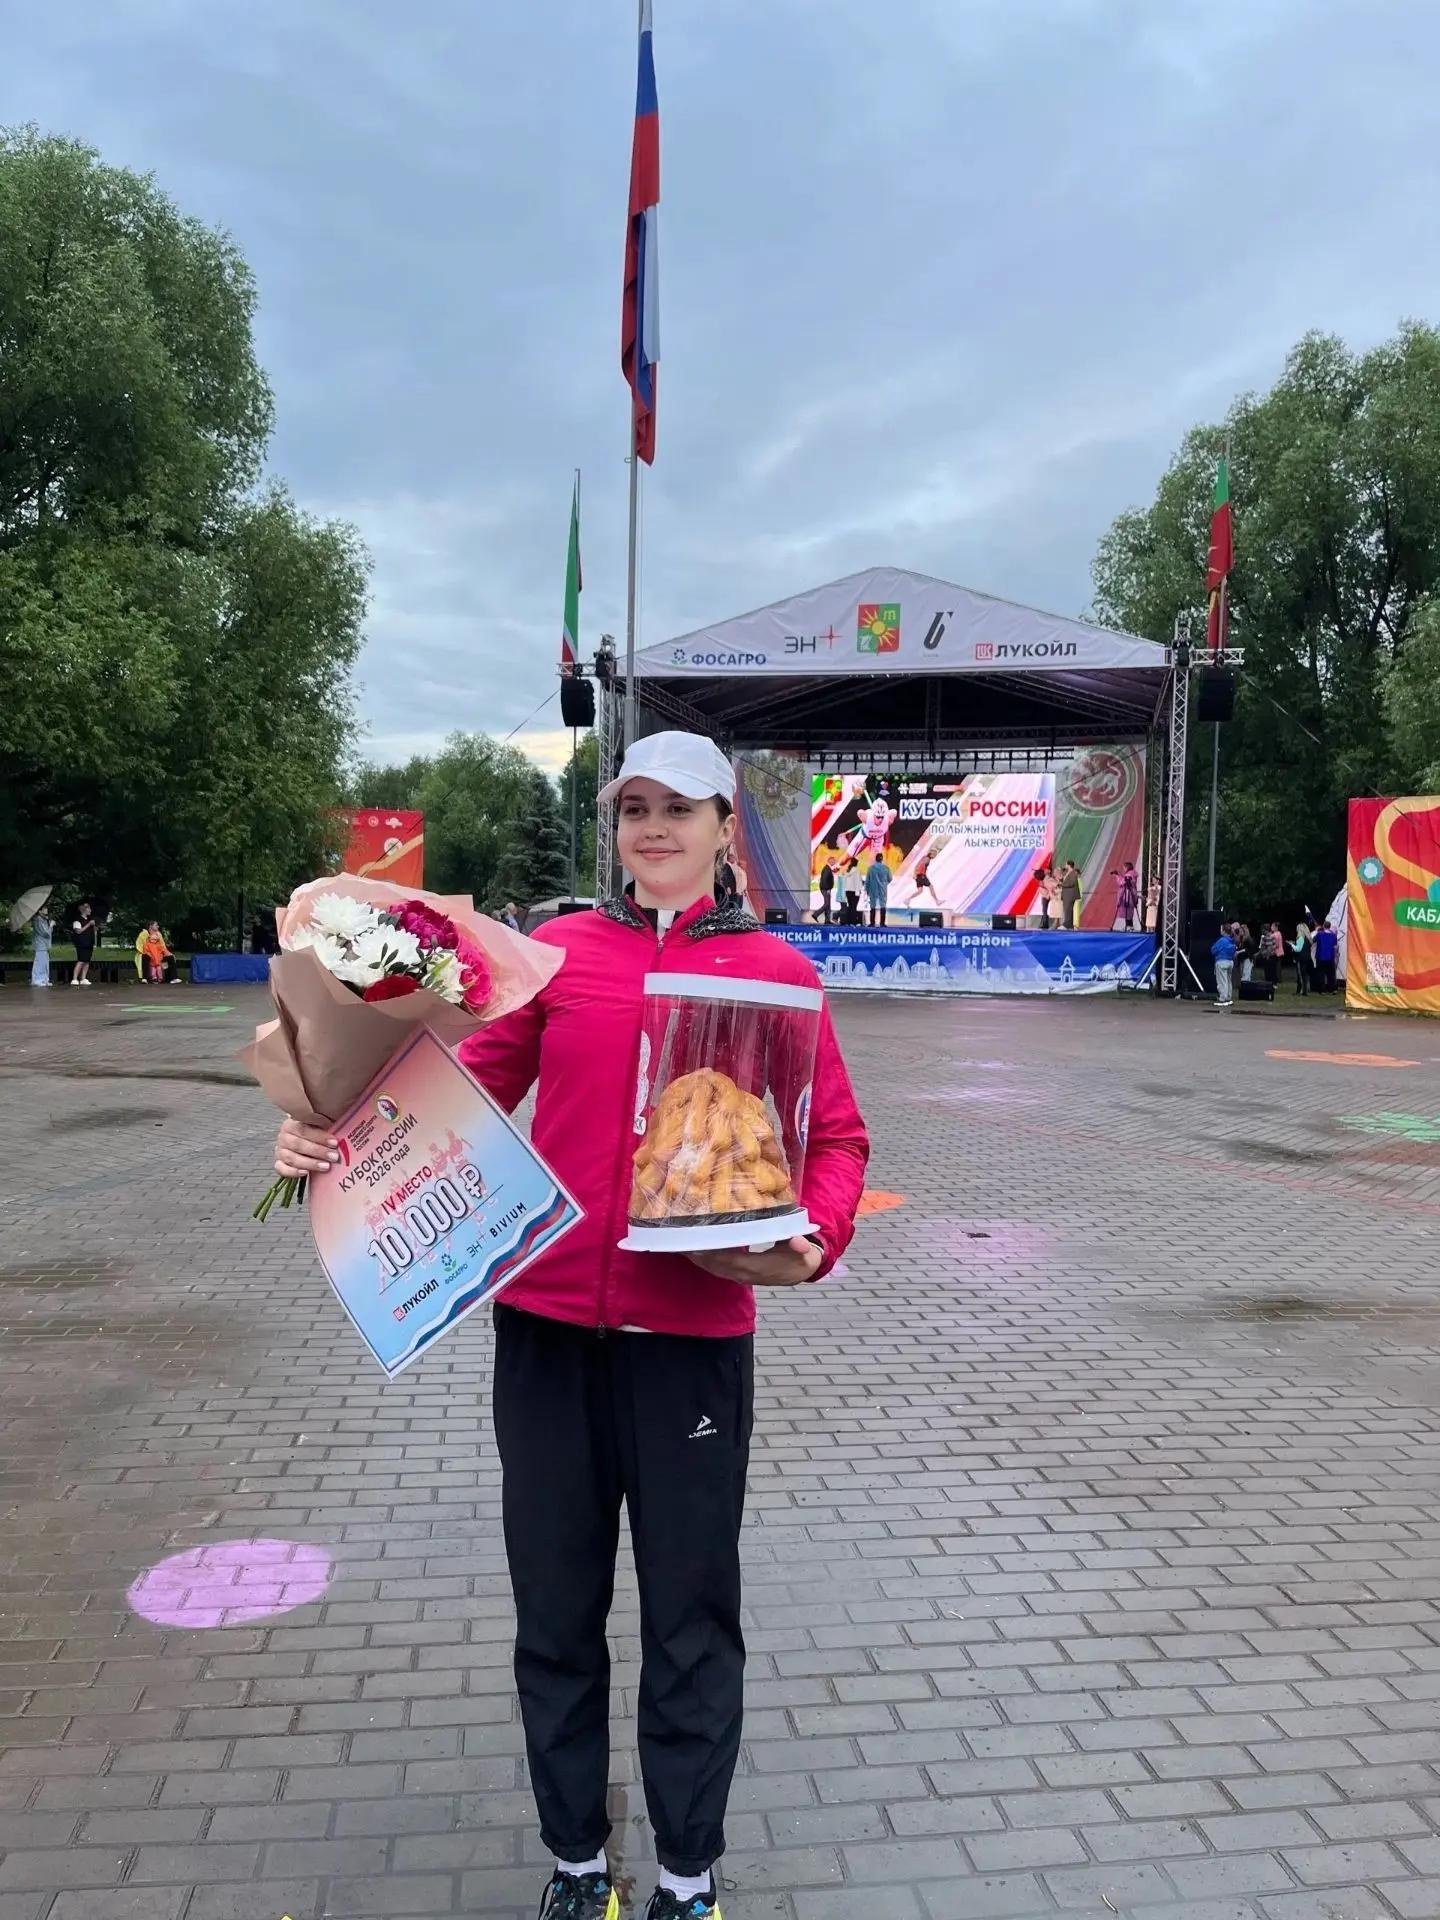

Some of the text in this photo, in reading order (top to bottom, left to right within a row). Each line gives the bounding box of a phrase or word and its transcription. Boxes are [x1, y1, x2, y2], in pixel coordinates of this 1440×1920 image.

[691, 653, 766, 666] ФОСАГРО
[994, 640, 1077, 658] ЛУКОЙЛ
[901, 800, 1047, 817] КУБОК РОССИИ
[931, 824, 1046, 834] ПО ЛЫЖНЫМ ГОНКАМ
[964, 837, 1046, 848] ЛЫЖЕРОЛЛЕРЫ
[828, 930, 957, 947] муниципальный
[961, 931, 1011, 947] район
[338, 1112, 418, 1193] КУБОК РОССИИ
[366, 1143, 411, 1188] 2026 года
[380, 1165, 432, 1216] IV МЕСТО
[367, 1226, 414, 1277] 10
[404, 1177, 468, 1247] 000
[489, 1202, 527, 1238] BIVIUM
[402, 1278, 440, 1314] ЛУКОЙЛ
